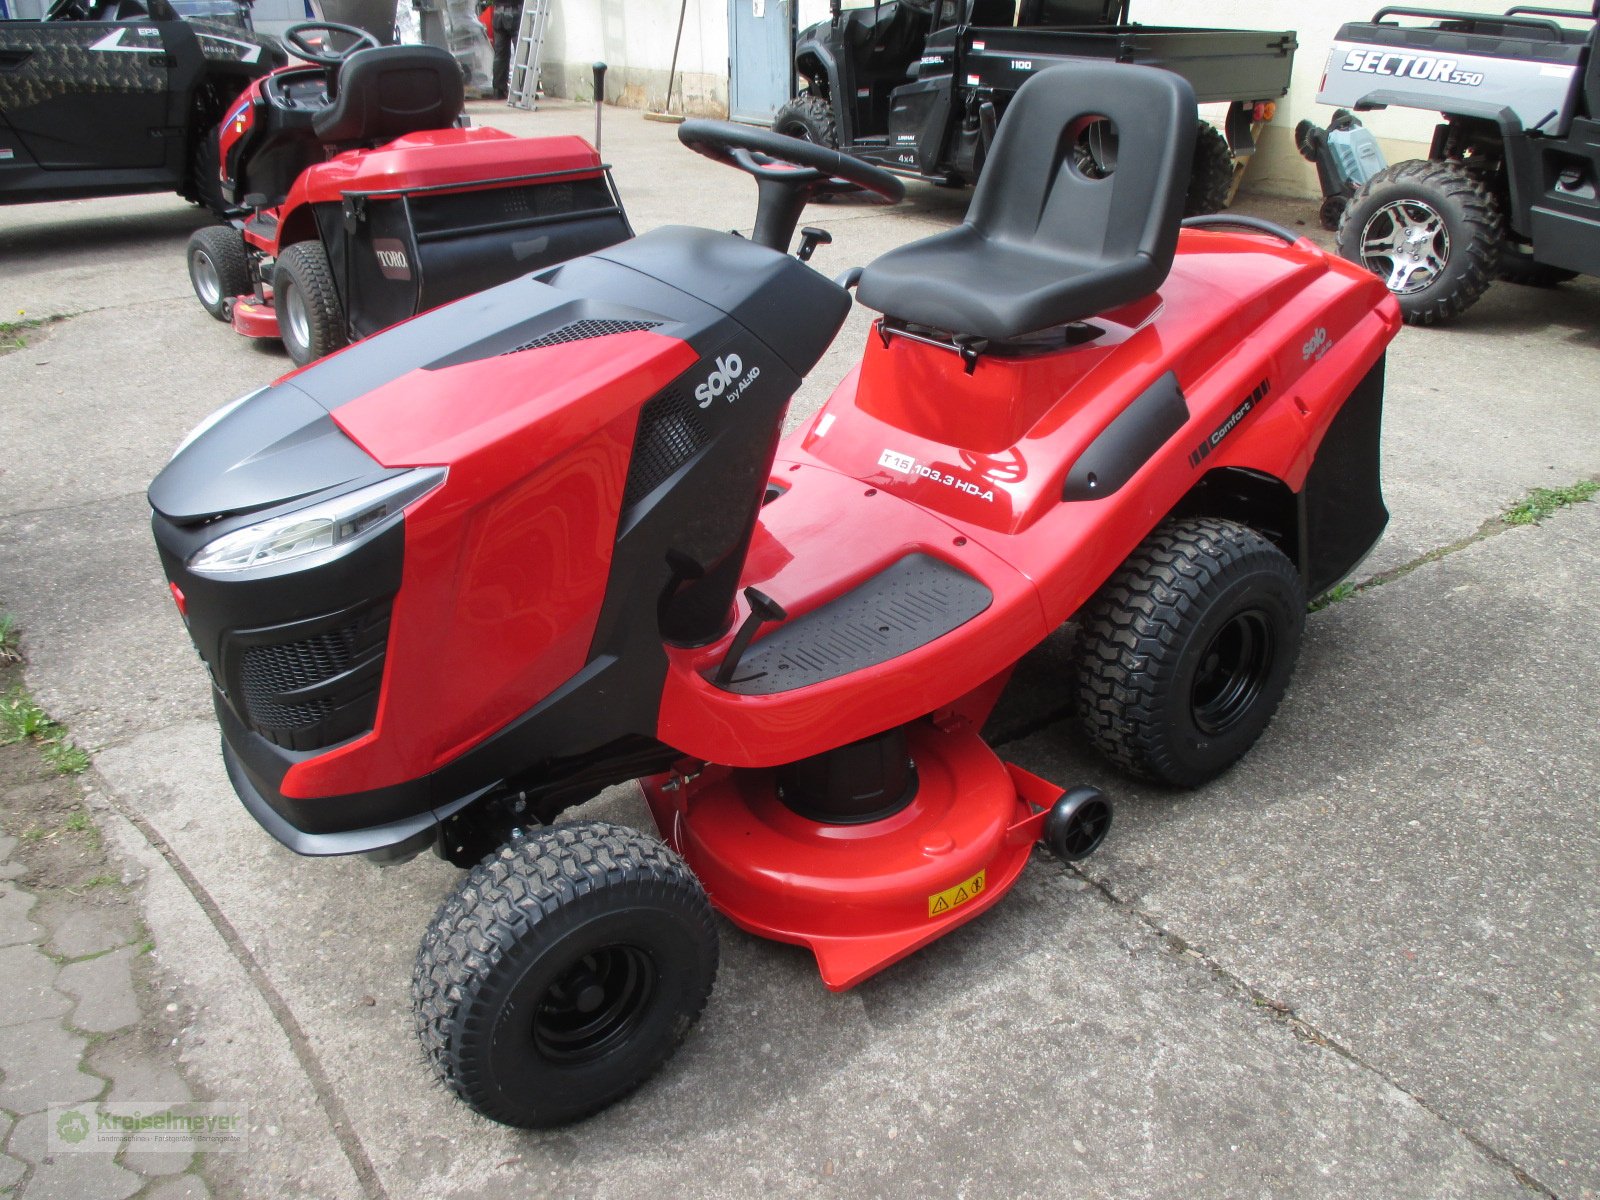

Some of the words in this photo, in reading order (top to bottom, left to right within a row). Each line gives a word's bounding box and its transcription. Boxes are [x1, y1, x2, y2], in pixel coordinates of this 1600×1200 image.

[1011, 60, 1032, 70] 1100
[1342, 49, 1458, 83] SECTOR
[1449, 71, 1485, 86] 550
[898, 154, 914, 163] 4x4
[376, 250, 408, 268] TORO
[694, 353, 743, 409] solo
[726, 389, 740, 403] by
[1210, 401, 1251, 445] Comfort
[894, 457, 910, 470] 15
[955, 480, 994, 502] HD-A
